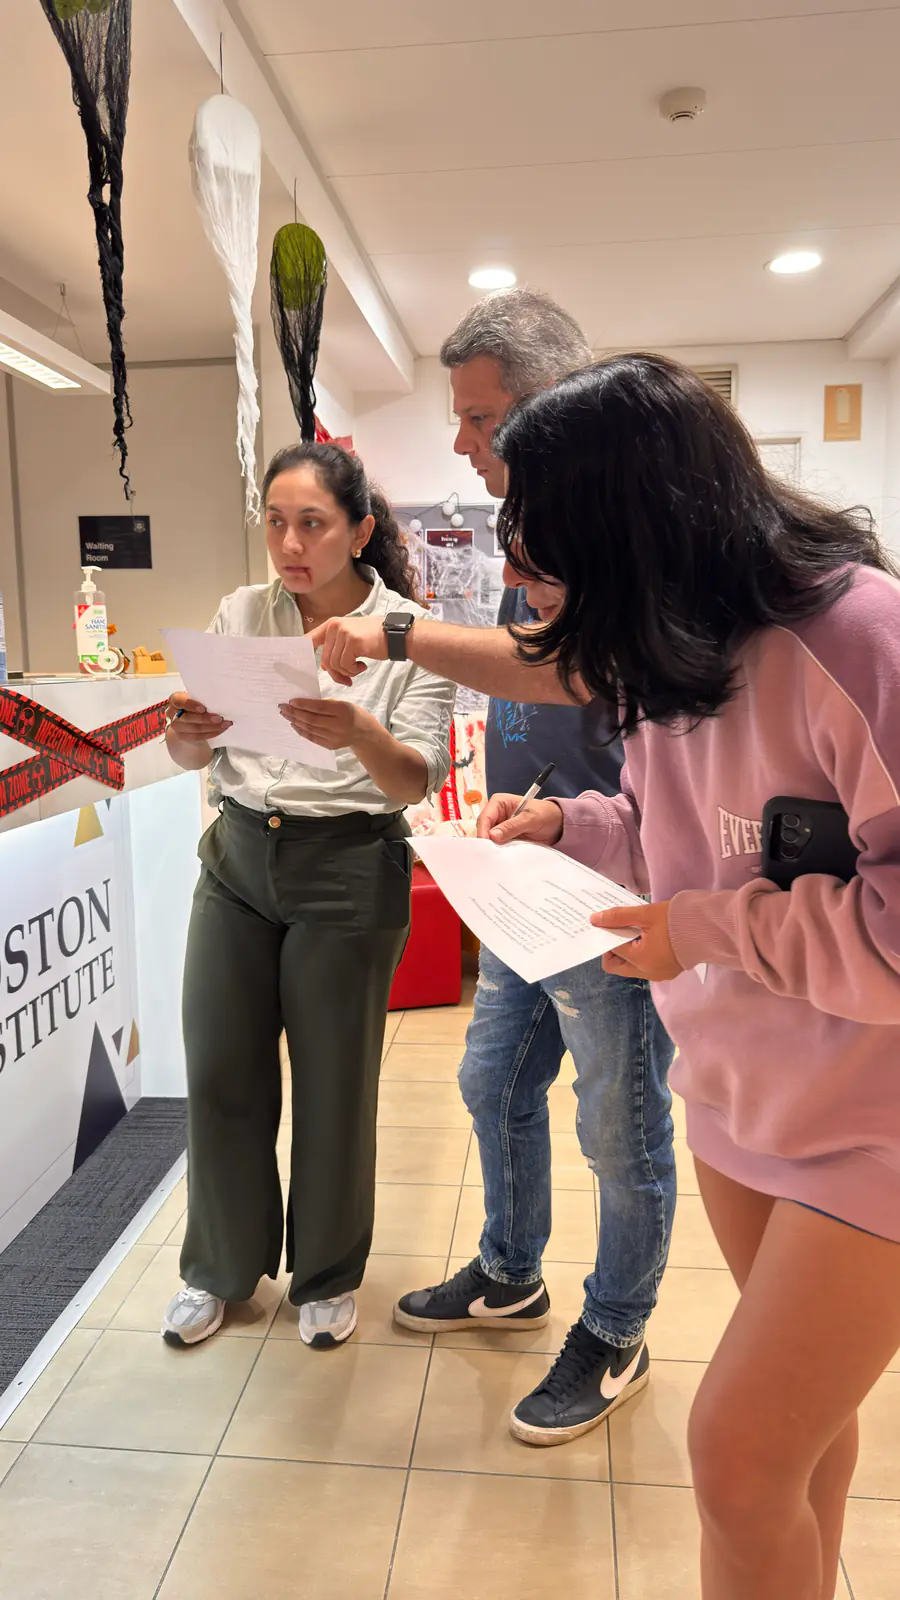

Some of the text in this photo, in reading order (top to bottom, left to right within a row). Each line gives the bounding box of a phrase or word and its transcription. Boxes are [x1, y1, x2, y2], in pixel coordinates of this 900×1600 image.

[85, 542, 114, 551] Waiting
[86, 553, 108, 561] Room
[35, 717, 93, 768] INFECTION ZONE
[117, 715, 146, 748] INFECTION
[7, 769, 33, 803] ZONE
[0, 878, 111, 994] STON
